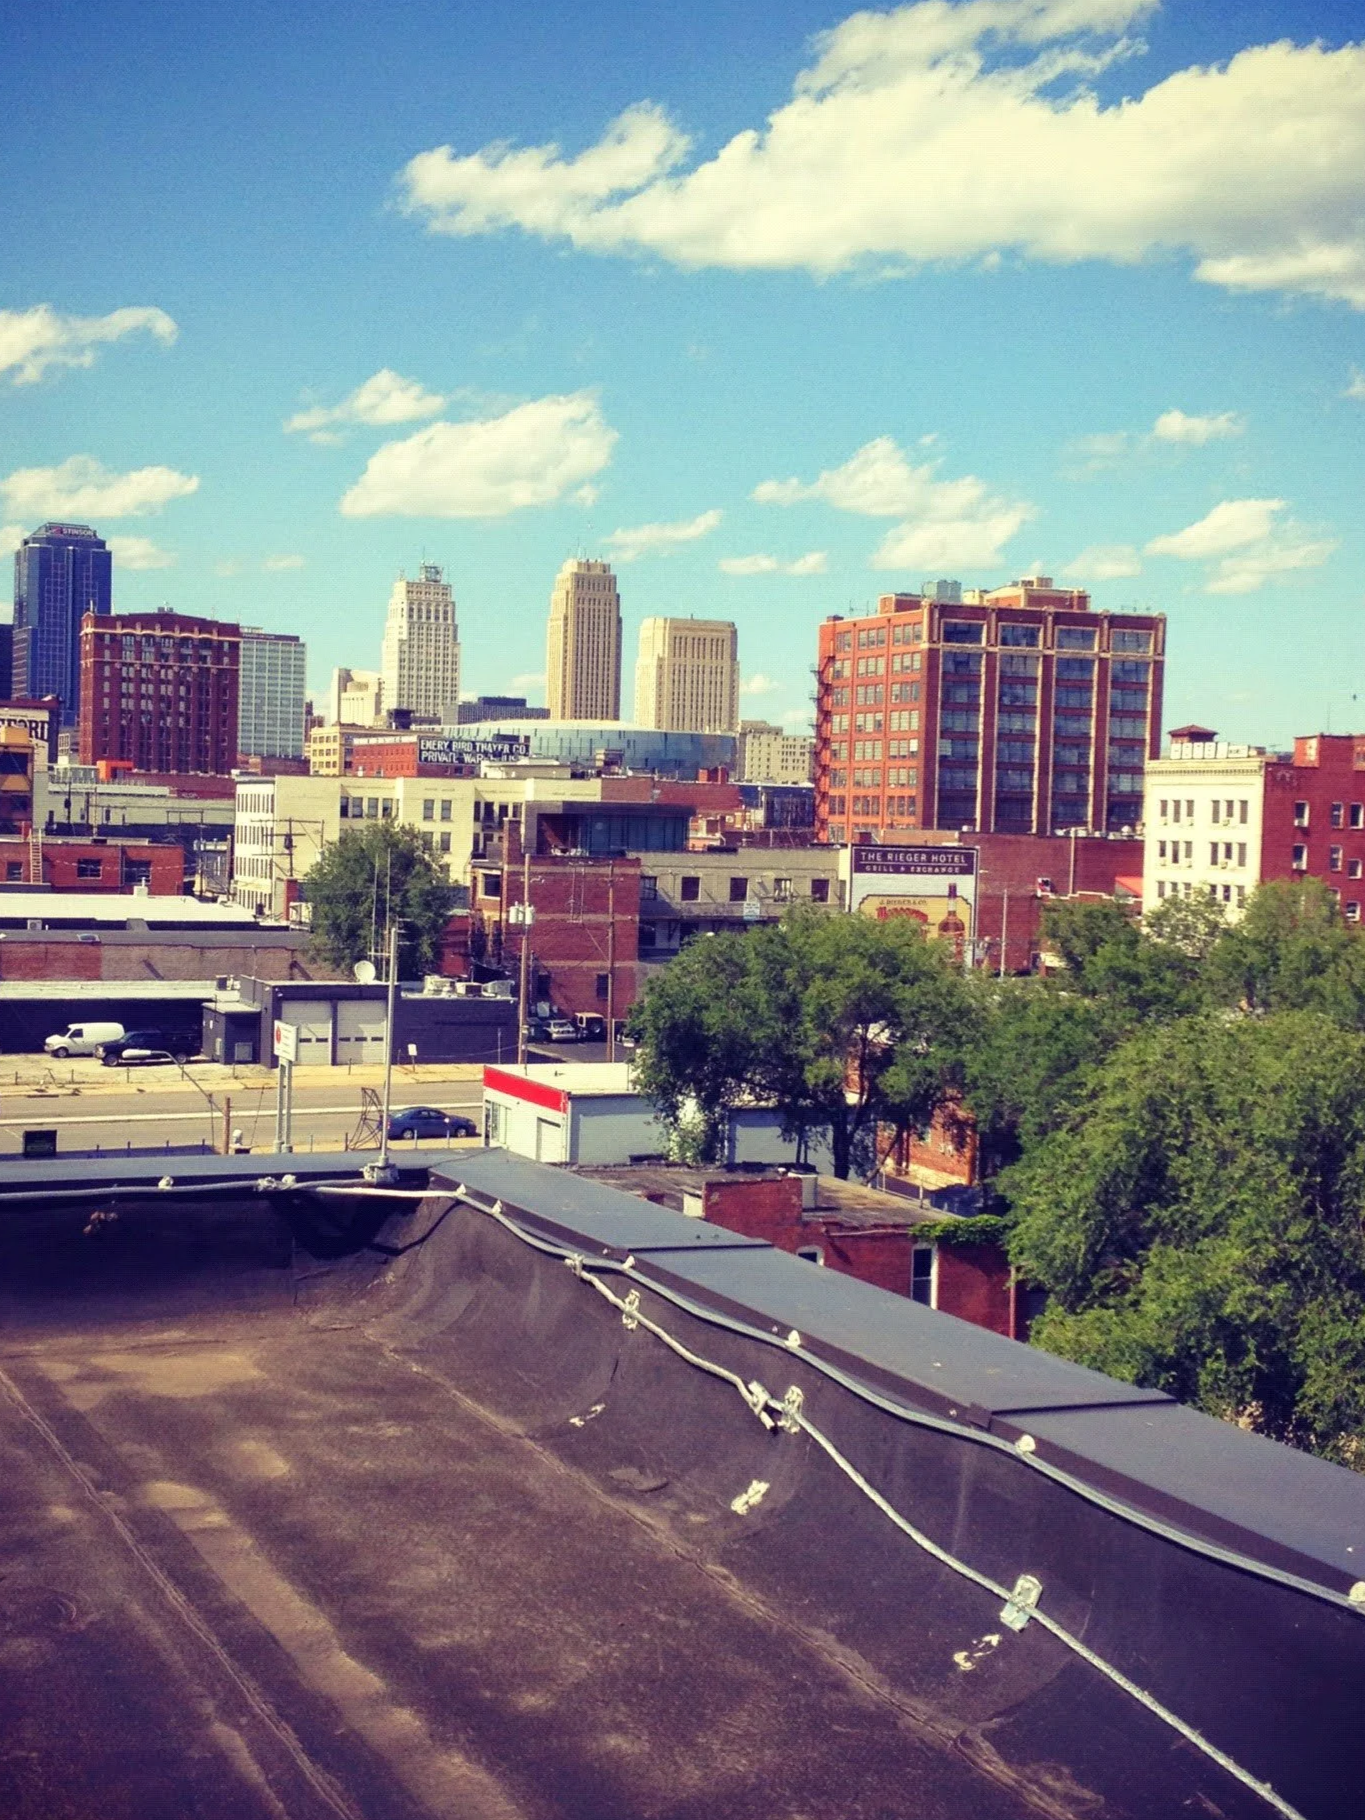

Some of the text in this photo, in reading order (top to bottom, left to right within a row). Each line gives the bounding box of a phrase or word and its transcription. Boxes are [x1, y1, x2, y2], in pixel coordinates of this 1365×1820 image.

[420, 739, 449, 751] EMERY
[452, 741, 473, 752] BIRD
[475, 743, 509, 754] THAYER
[421, 751, 458, 763] PRIVATE
[861, 852, 966, 863] THE RIEGER HOTEL
[910, 866, 960, 874] EXCHANGE
